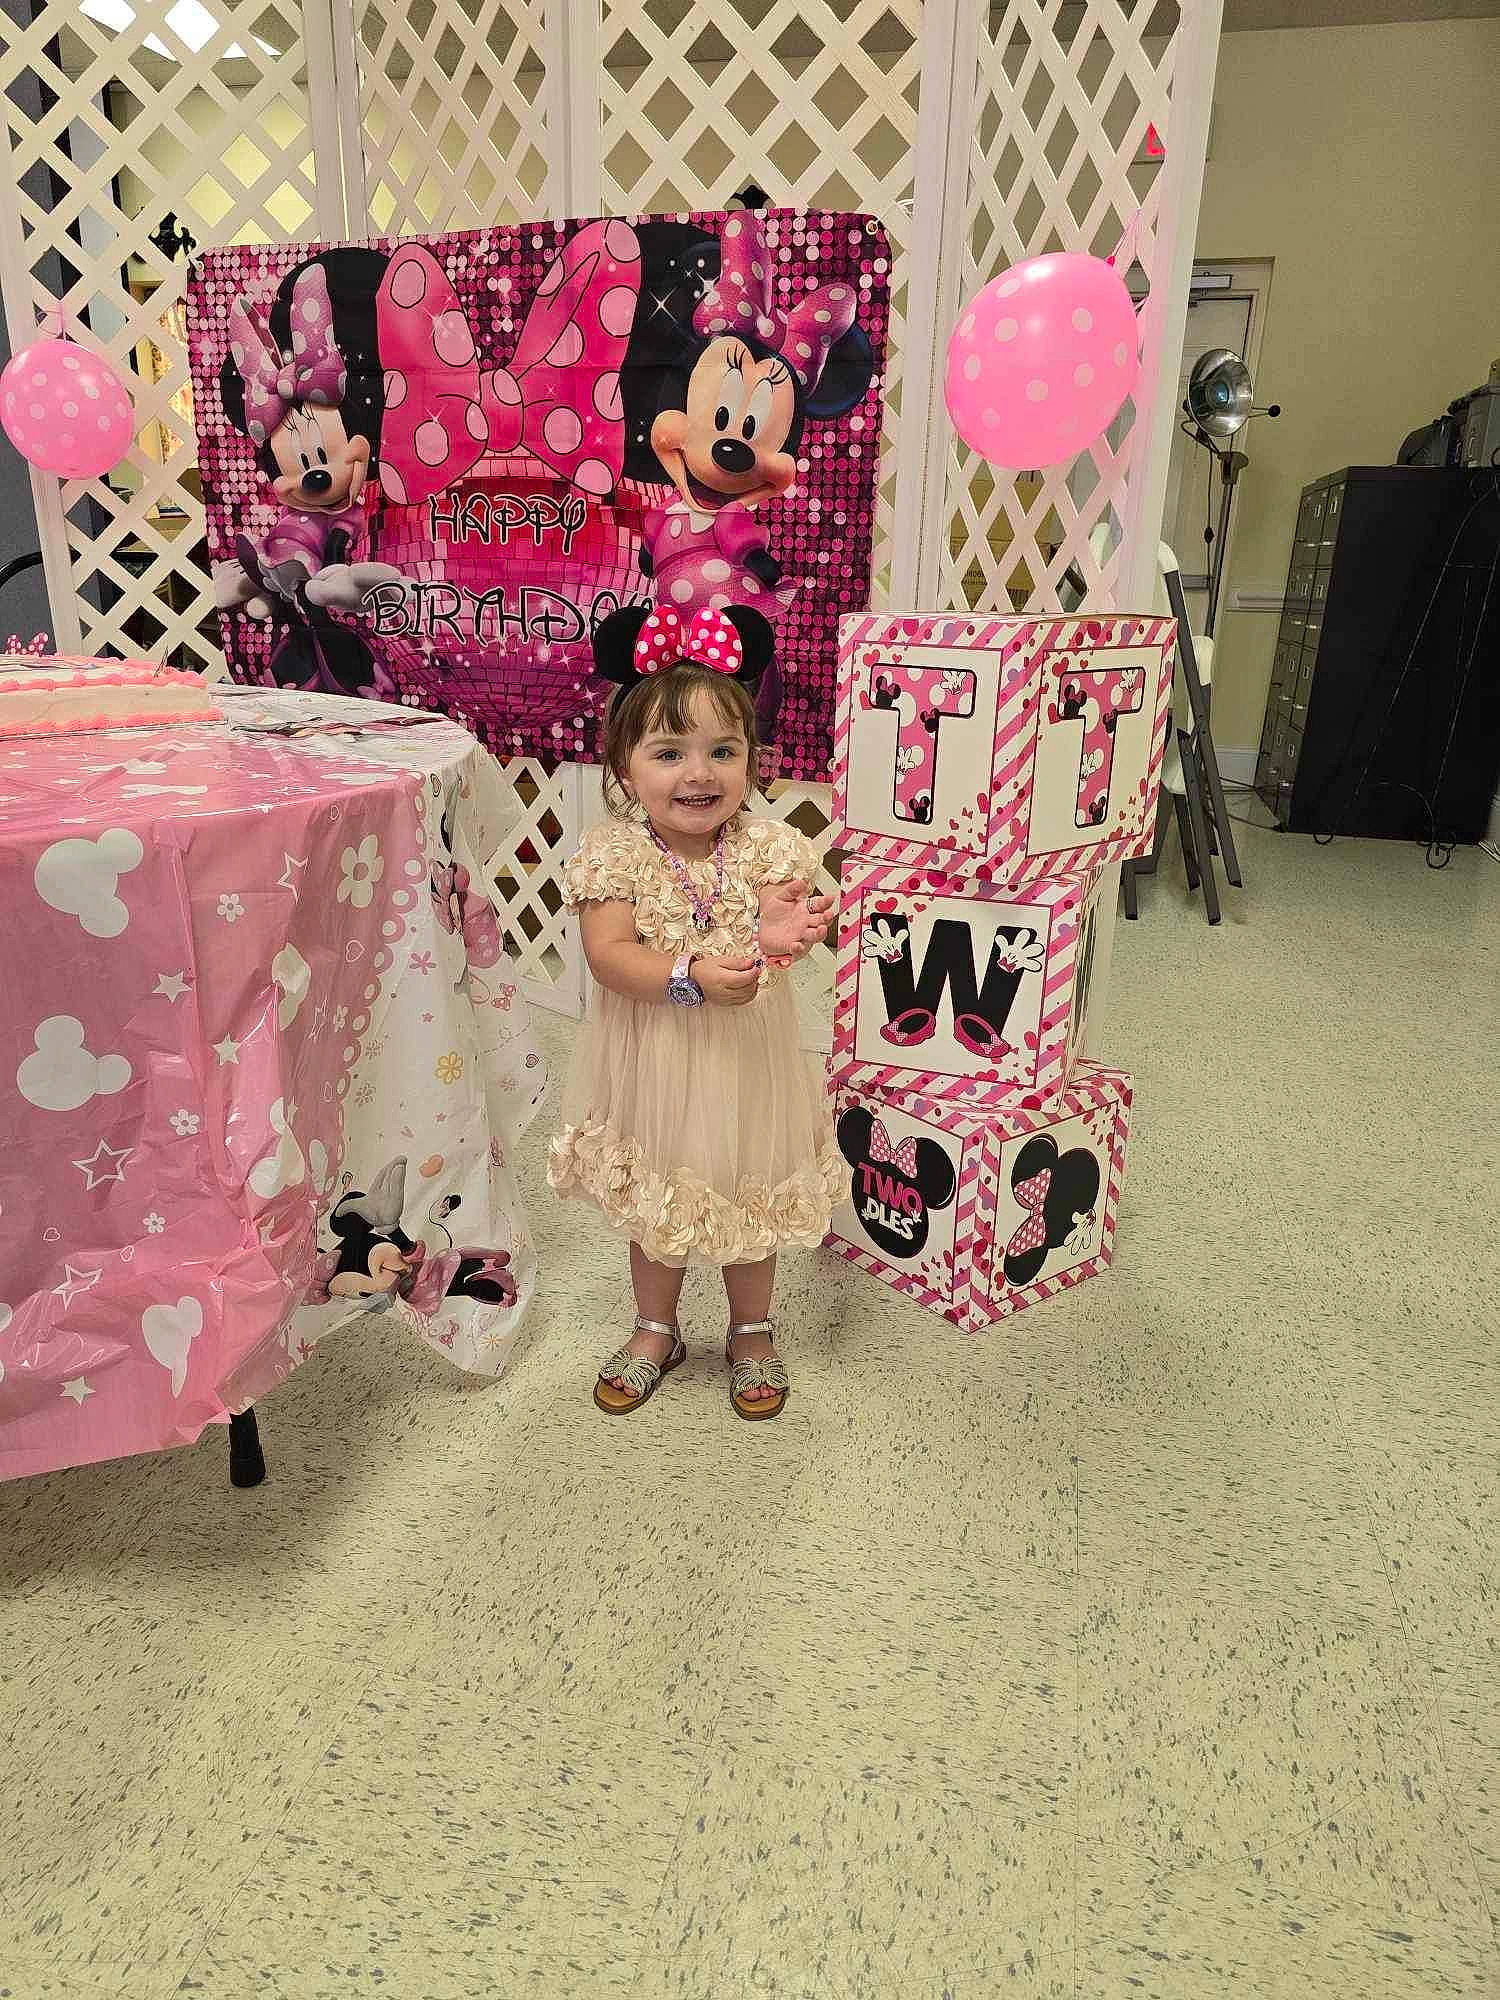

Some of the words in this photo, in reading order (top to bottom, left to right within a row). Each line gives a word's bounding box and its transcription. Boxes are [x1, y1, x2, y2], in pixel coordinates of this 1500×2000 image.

[428, 493, 587, 555] HAPPY
[361, 582, 655, 647] BIRTHDA
[868, 662, 978, 826] T
[1057, 667, 1147, 830] T
[866, 912, 1040, 1058] W
[858, 1161, 923, 1219] TWO
[865, 1195, 915, 1240] DLES
